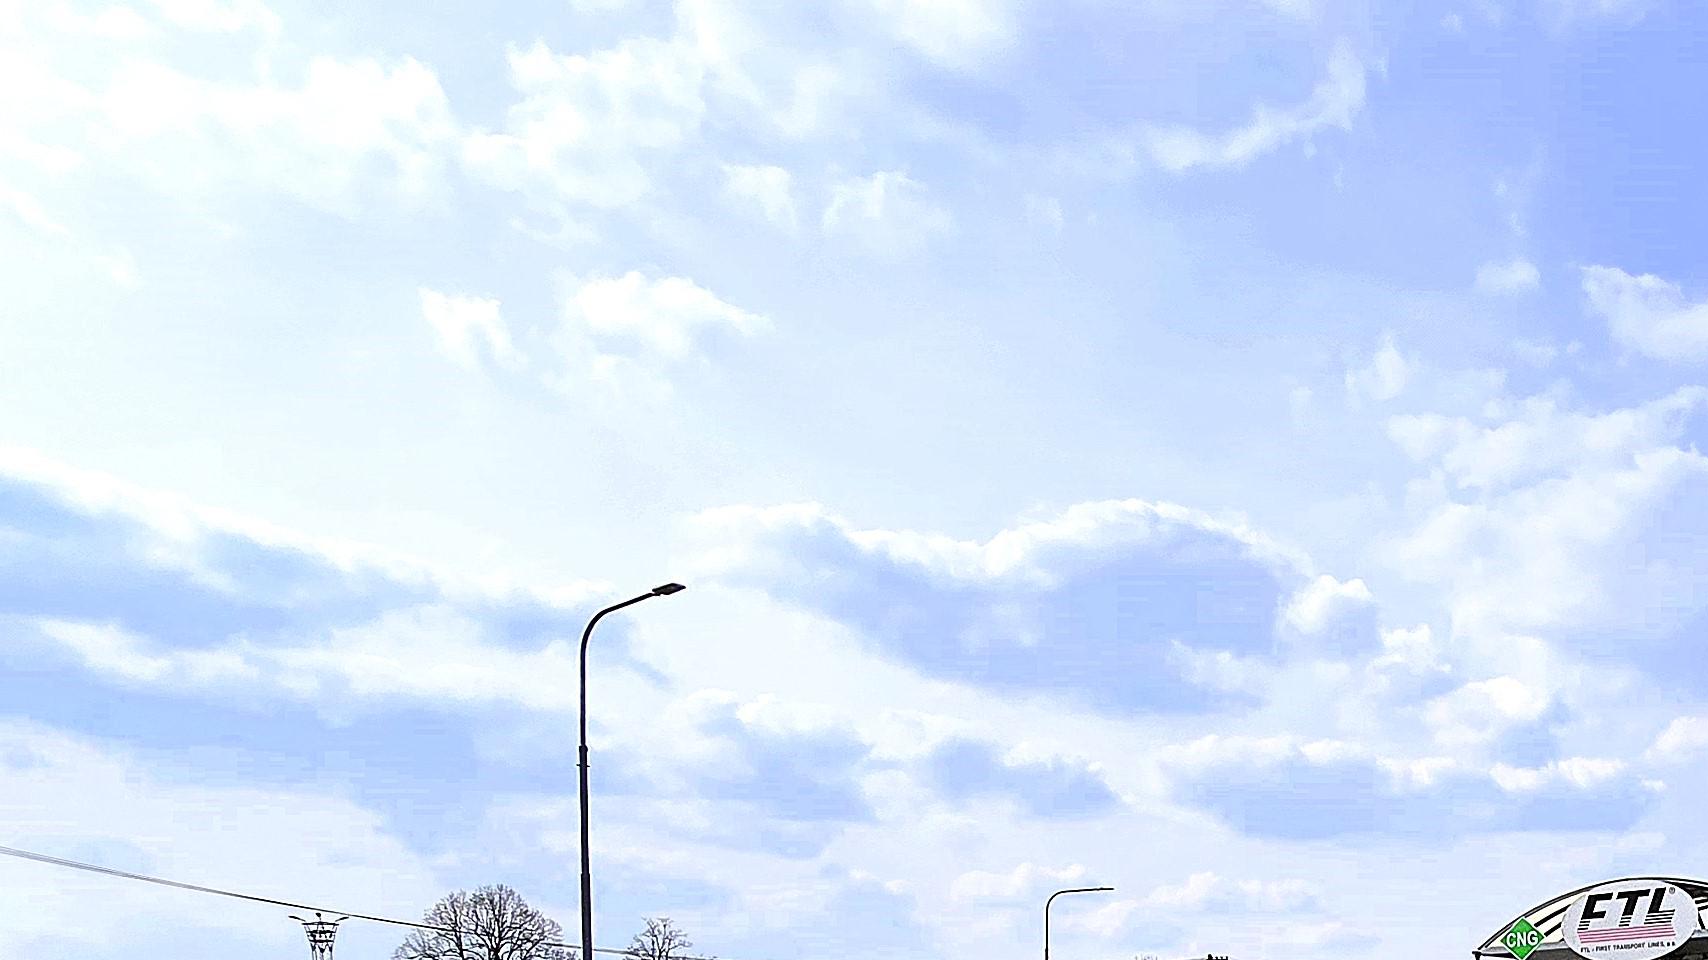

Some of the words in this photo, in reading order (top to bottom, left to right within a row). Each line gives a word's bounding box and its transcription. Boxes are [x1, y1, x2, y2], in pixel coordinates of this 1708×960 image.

[1506, 930, 1539, 948] CNG
[1595, 944, 1611, 952] FIRST
[1612, 942, 1646, 950] TRANSPORT
